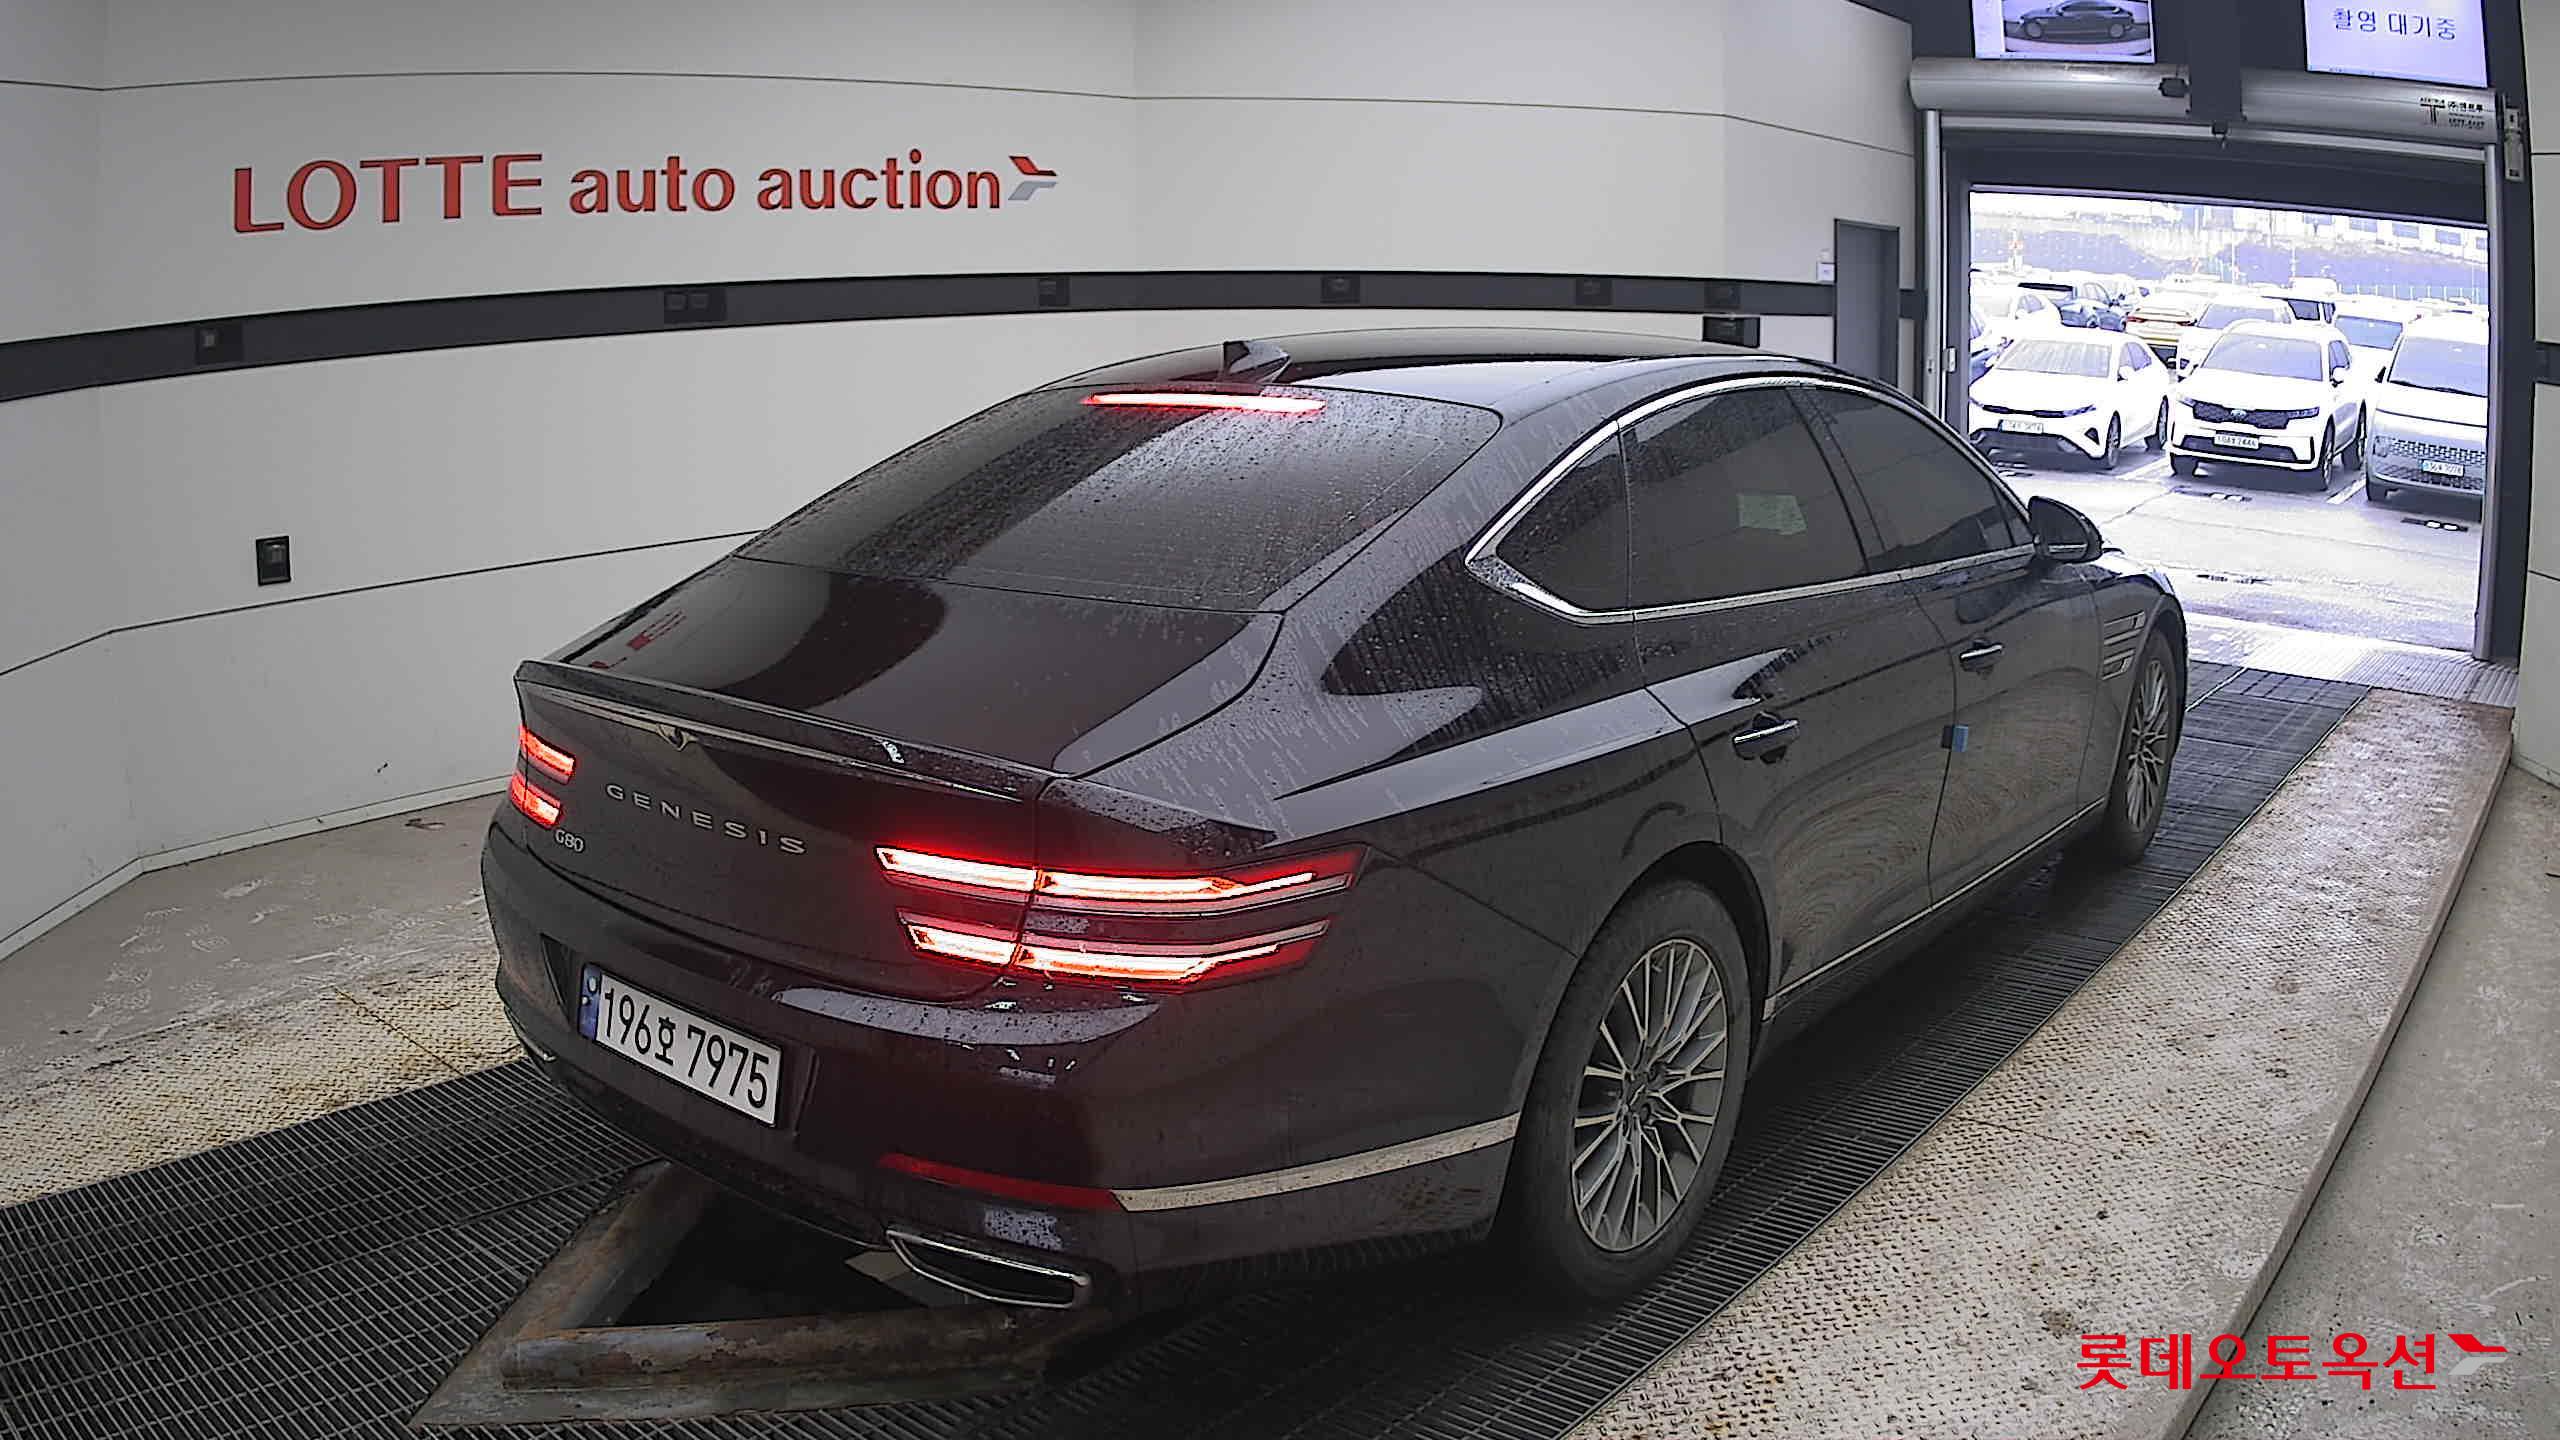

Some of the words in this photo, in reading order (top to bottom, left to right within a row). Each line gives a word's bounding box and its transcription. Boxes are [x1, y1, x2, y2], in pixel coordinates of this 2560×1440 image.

[2333, 7, 2377, 33] 촬영
[2387, 12, 2456, 41] 대기중
[233, 152, 543, 234] LOTTE
[568, 155, 736, 215] auto
[757, 148, 1001, 210] auction
[554, 828, 585, 853] G80
[606, 783, 806, 855] GENESIS
[604, 987, 676, 1067] 196호
[686, 1023, 770, 1109] 7975
